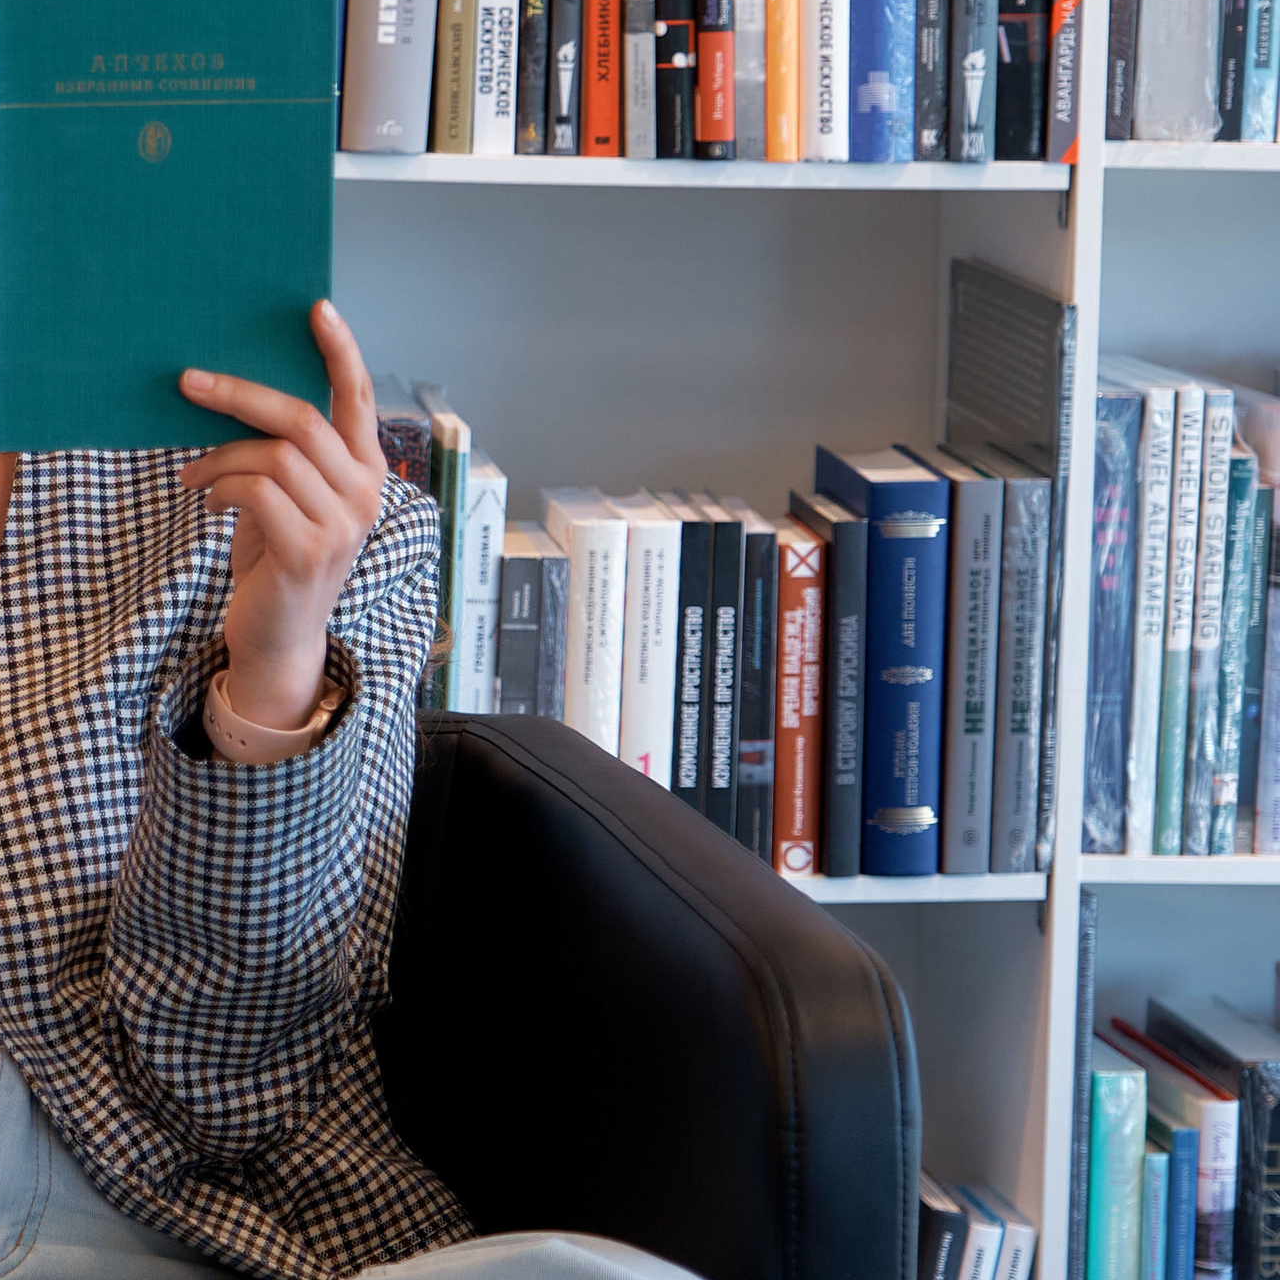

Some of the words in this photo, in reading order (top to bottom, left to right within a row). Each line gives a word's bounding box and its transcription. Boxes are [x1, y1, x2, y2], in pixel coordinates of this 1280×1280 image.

[479, 7, 495, 94] ИСКУССТВО
[1060, 0, 1076, 24] НА
[158, 77, 256, 92] СОЧИНЕНИЯ
[495, 6, 513, 118] СФЕРИЧЕСКОЕ
[818, 54, 833, 136] ИСКУССТВО
[1055, 28, 1076, 123] АВАНГАРД:
[1178, 409, 1199, 526] WILHELM
[1209, 415, 1230, 505] SIMON
[1141, 502, 1166, 637] ALTHAMER
[1171, 537, 1195, 637] SASNAL
[1200, 514, 1226, 641] STARLING
[682, 606, 703, 702] ПРОСТРАНСТВО
[714, 606, 735, 702] ПРОСТРАНСТВО
[839, 615, 859, 697] БРУСКИНА
[678, 704, 699, 788] ИЗУМЛЕННОЕ
[711, 704, 732, 788] ИЗУМЛЕННОЕ
[837, 701, 857, 770] СТОРОНУ
[905, 702, 920, 805] ПЕТРОВ-ВОДКИН
